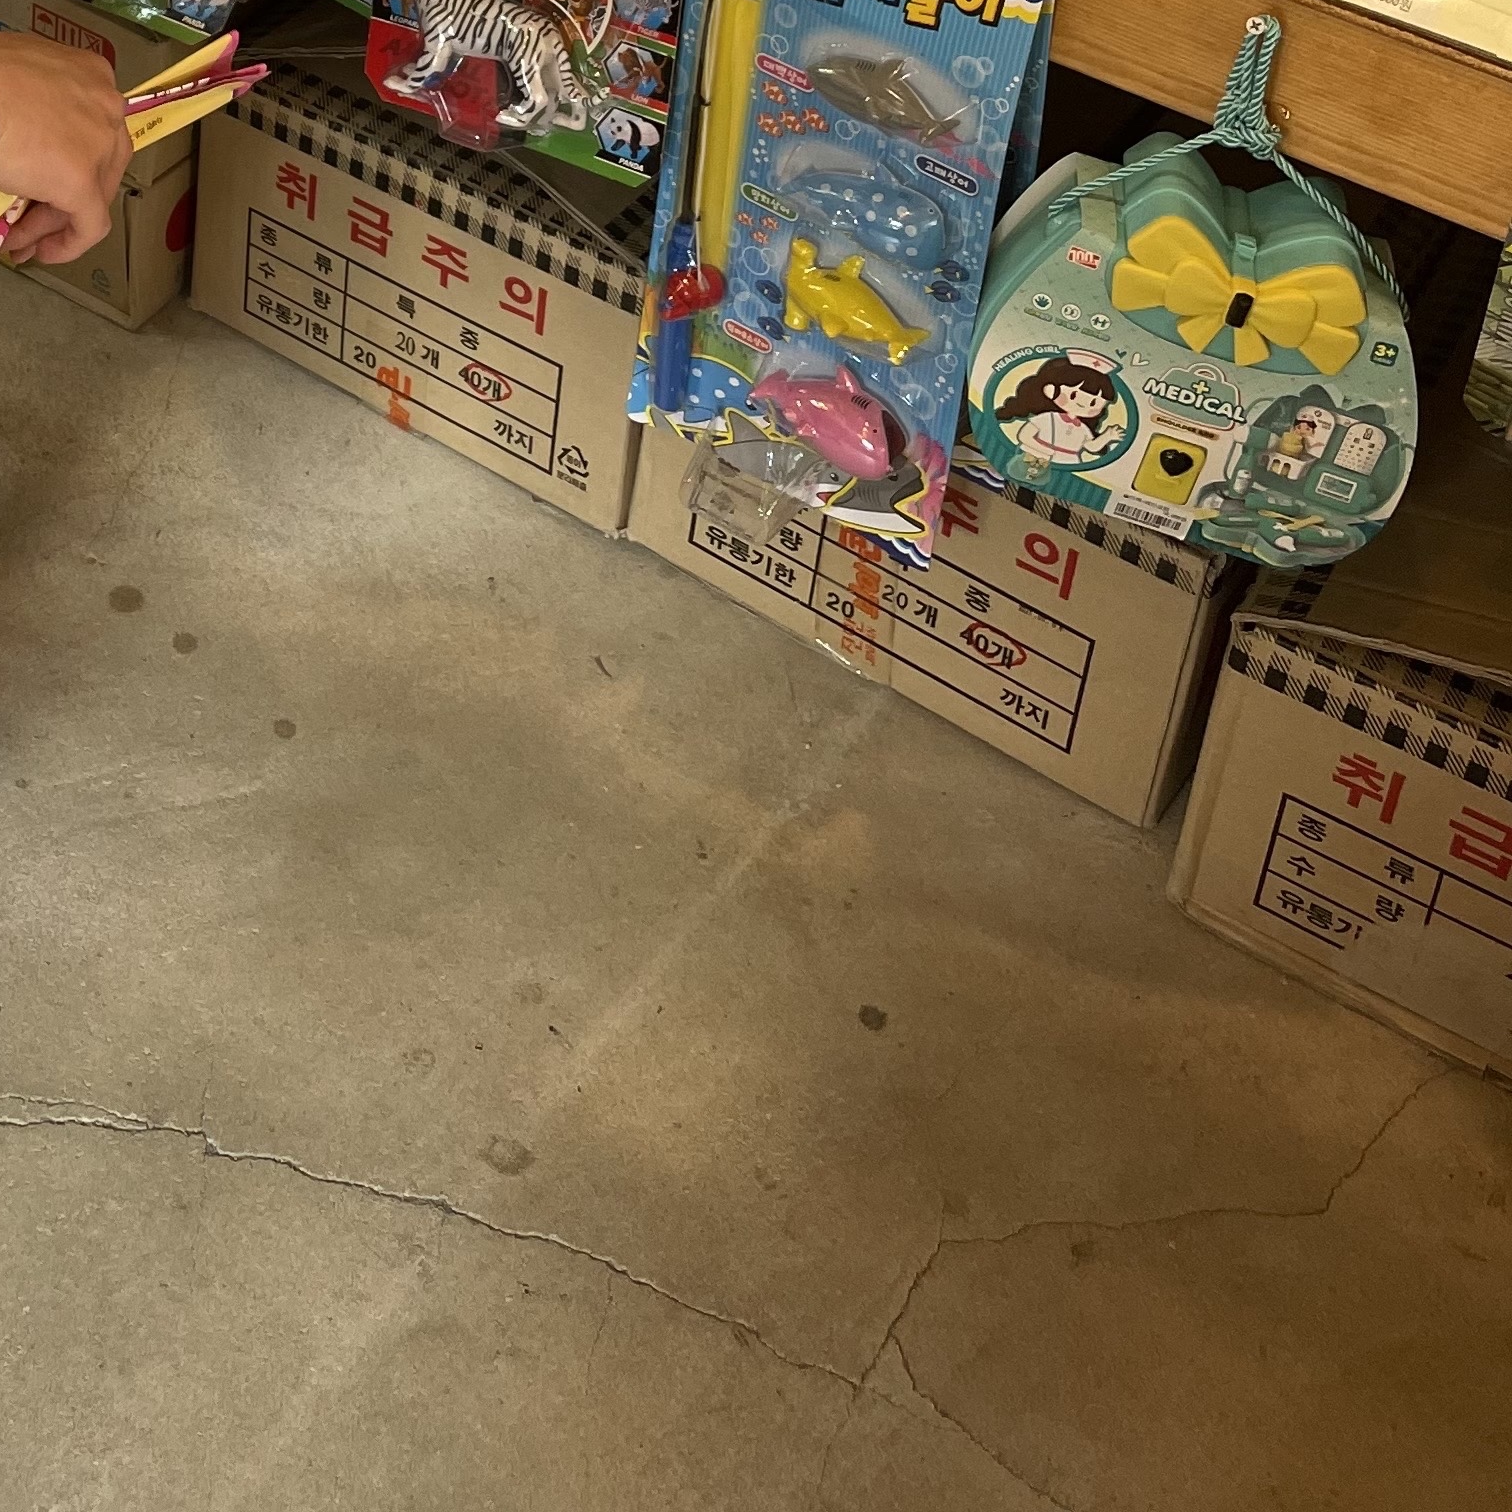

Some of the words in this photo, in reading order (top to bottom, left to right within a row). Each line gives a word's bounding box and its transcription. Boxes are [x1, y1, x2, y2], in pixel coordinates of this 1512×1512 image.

[388, 14, 419, 29] LEOPAR
[630, 94, 650, 105] LION
[617, 156, 645, 173] PANDA
[924, 159, 970, 189] 고래상어
[993, 346, 1033, 373] HEALING
[1034, 344, 1061, 355] GIRL
[1374, 344, 1396, 359] 3+
[254, 292, 330, 346] 유통기한
[353, 345, 377, 370] 20
[492, 419, 534, 455] 까지
[458, 364, 503, 401] 40개
[1143, 377, 1248, 424] MEDICAL
[704, 524, 797, 589] 유통기한
[825, 592, 855, 619] 20
[999, 689, 1051, 731] 까지
[959, 625, 1016, 670] 40개
